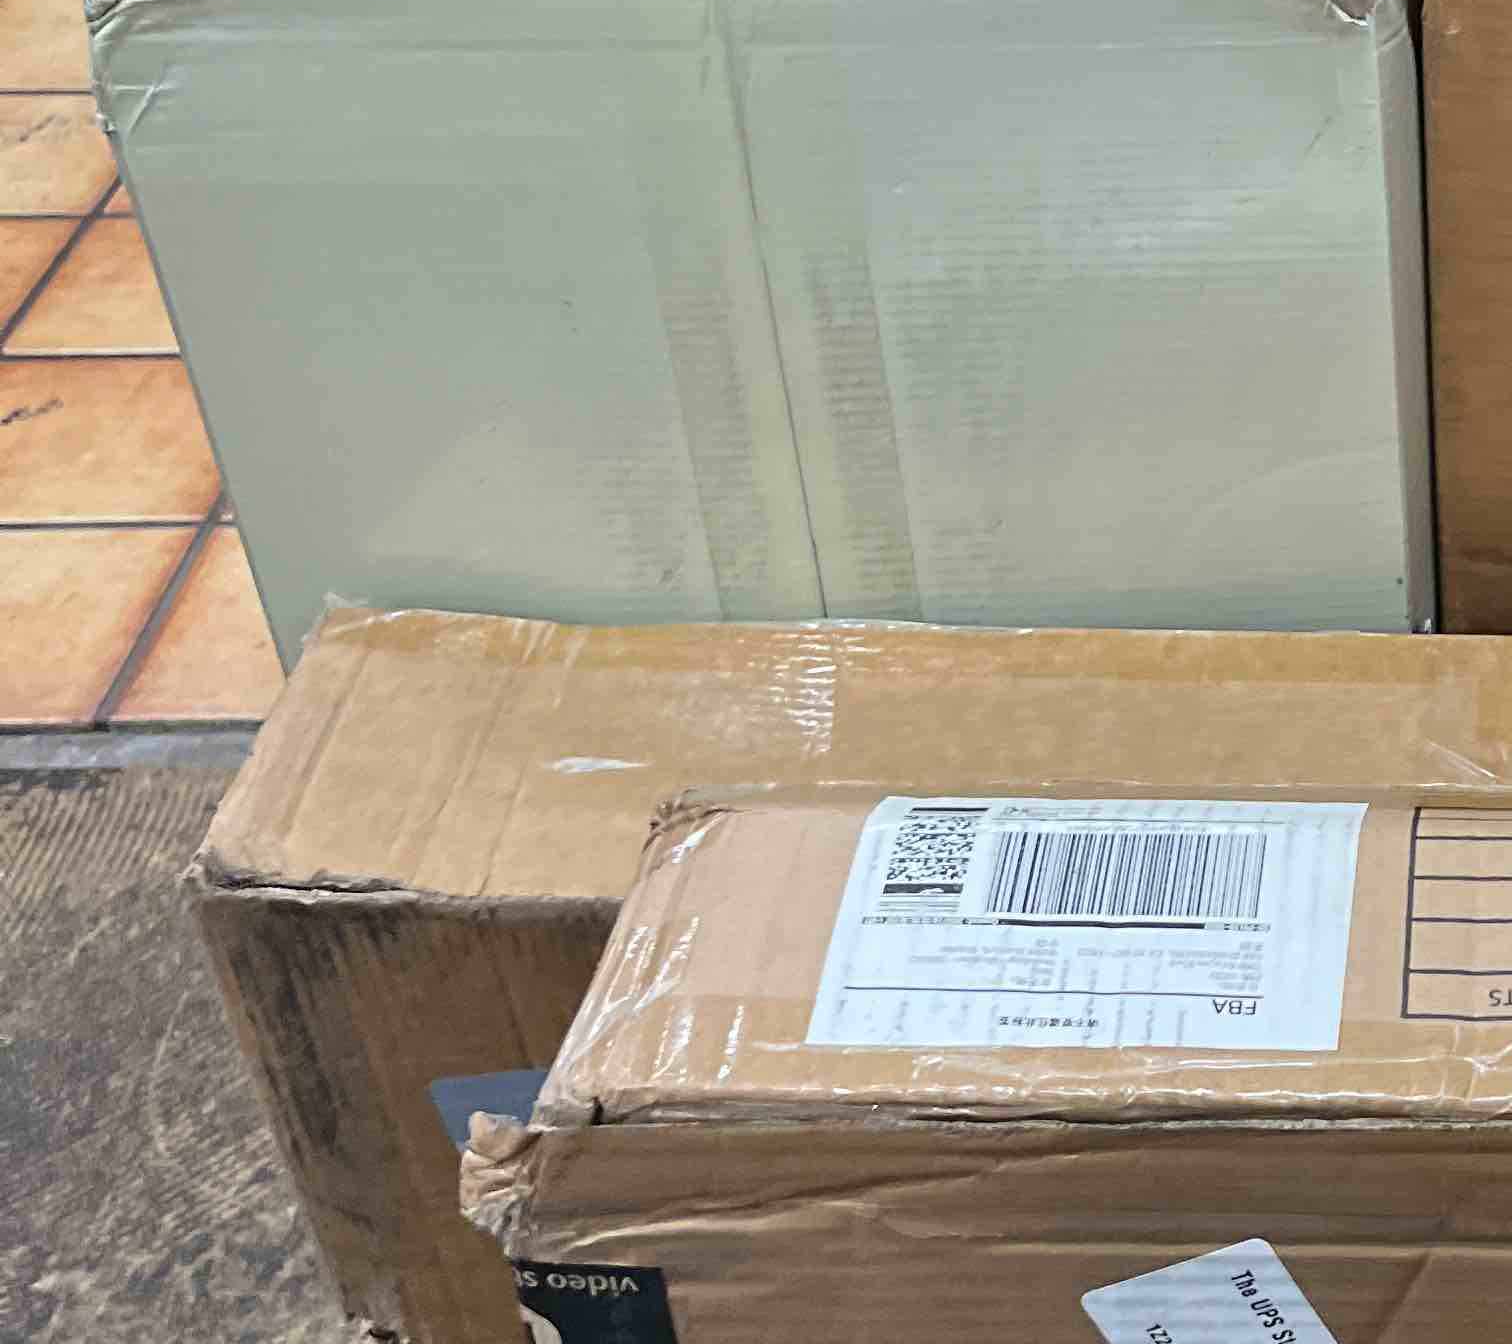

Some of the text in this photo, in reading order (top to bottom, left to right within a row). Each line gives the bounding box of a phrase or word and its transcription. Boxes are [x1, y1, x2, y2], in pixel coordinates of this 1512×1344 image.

[1211, 998, 1258, 1016] FBA
[547, 1272, 640, 1297] video
[1231, 1269, 1258, 1299] The
[1251, 1298, 1285, 1330] UPS
